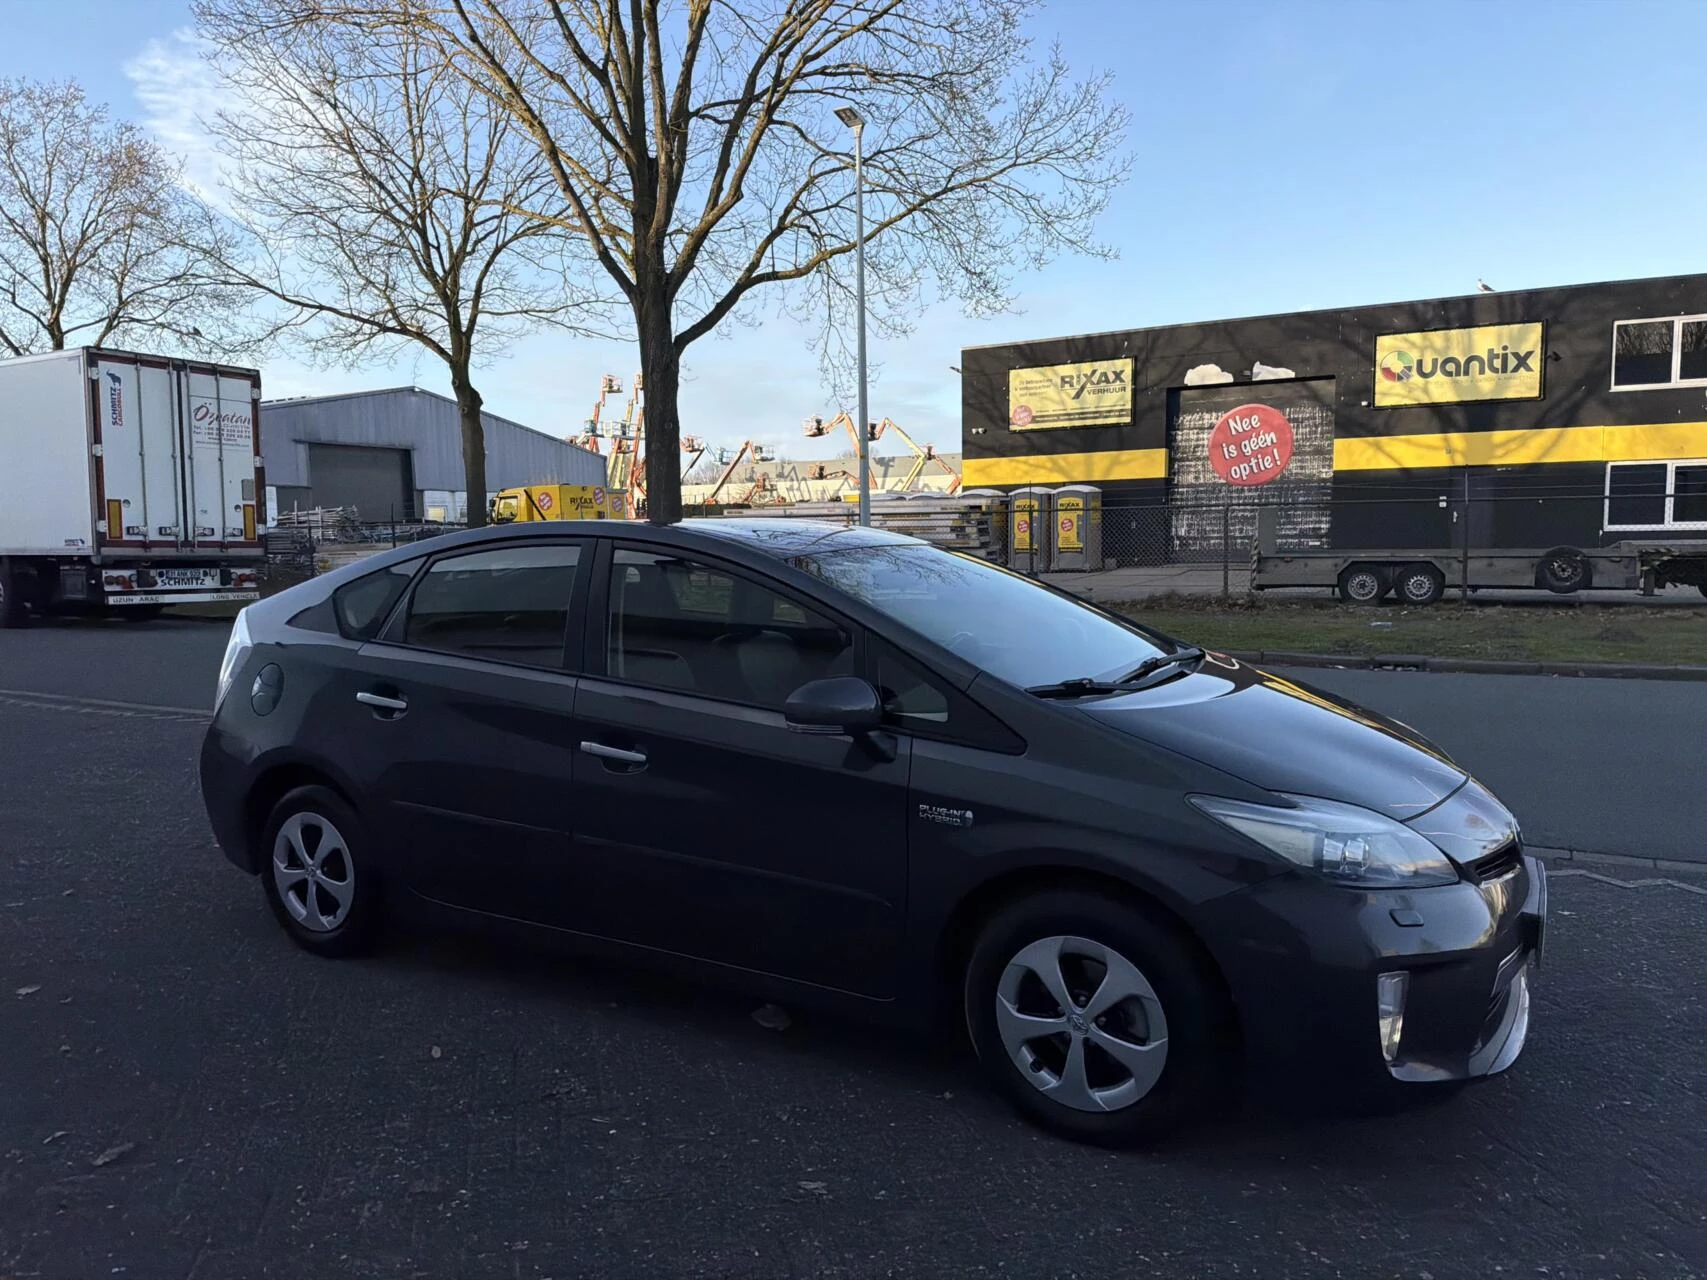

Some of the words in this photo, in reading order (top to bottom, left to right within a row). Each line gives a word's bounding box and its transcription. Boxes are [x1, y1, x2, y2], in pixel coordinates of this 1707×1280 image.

[1380, 344, 1535, 383] Quantix
[1087, 386, 1127, 396] VERHUUR
[110, 386, 118, 426] SCHMITZ
[1228, 414, 1260, 435] Nee
[1221, 443, 1238, 460] is
[1240, 429, 1277, 456] géén
[1230, 448, 1281, 481] optie!
[160, 577, 206, 587] SCHMITZ
[919, 804, 961, 816] PLUG-IN
